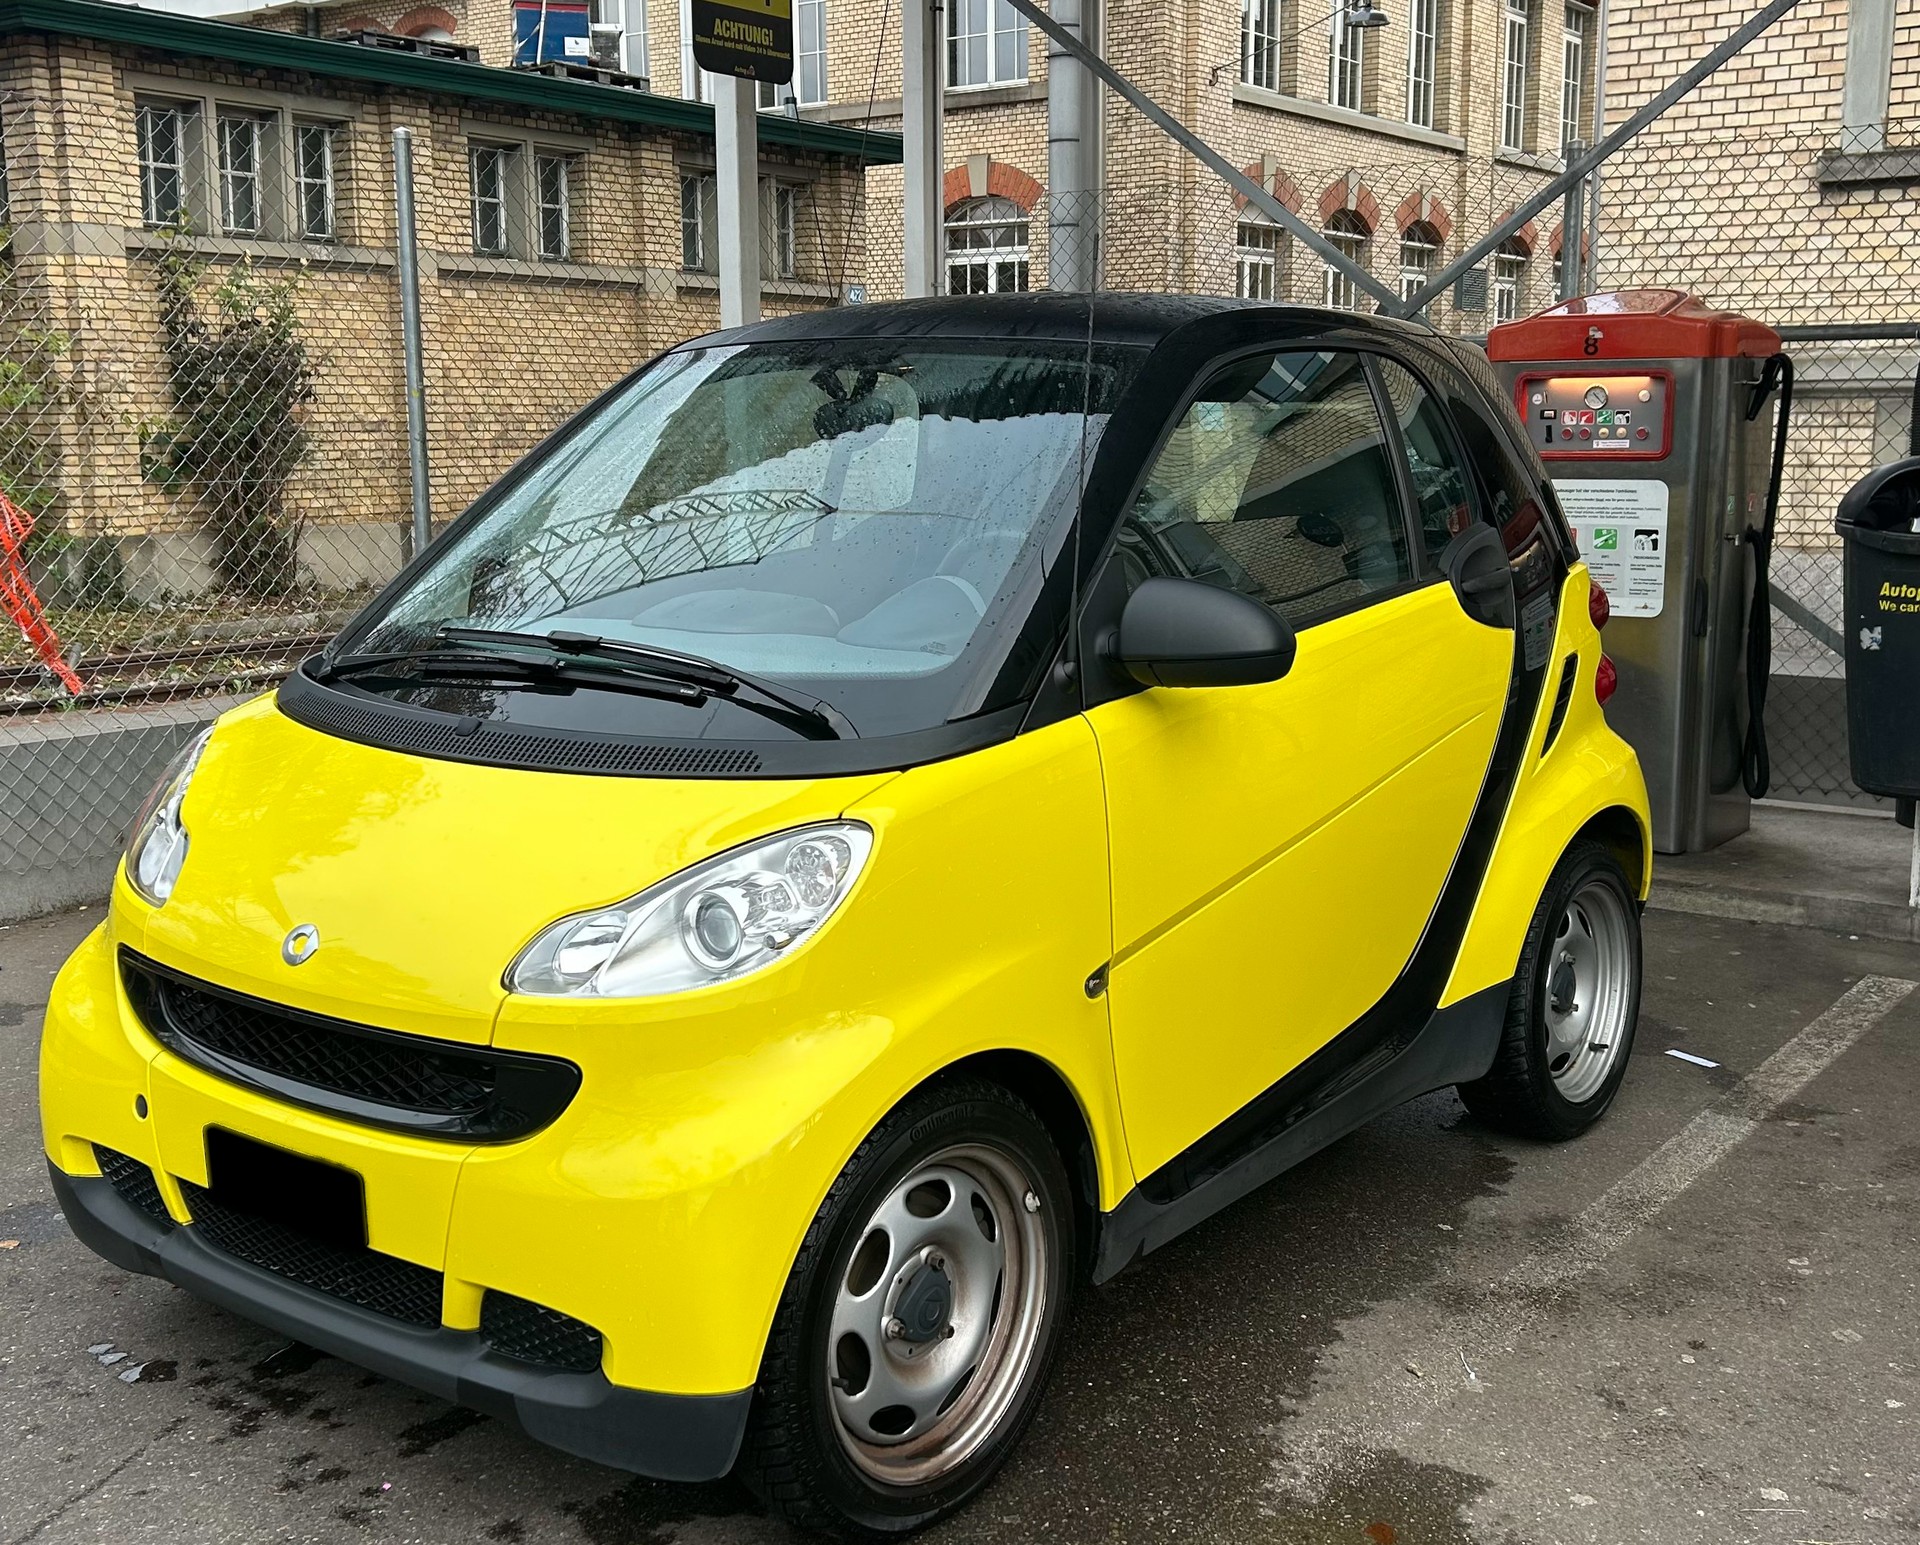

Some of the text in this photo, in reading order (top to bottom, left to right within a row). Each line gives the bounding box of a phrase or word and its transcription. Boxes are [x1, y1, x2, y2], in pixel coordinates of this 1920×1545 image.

[713, 18, 774, 47] ACHTUNG!
[1584, 334, 1599, 356] 8
[1879, 600, 1920, 613] We car
